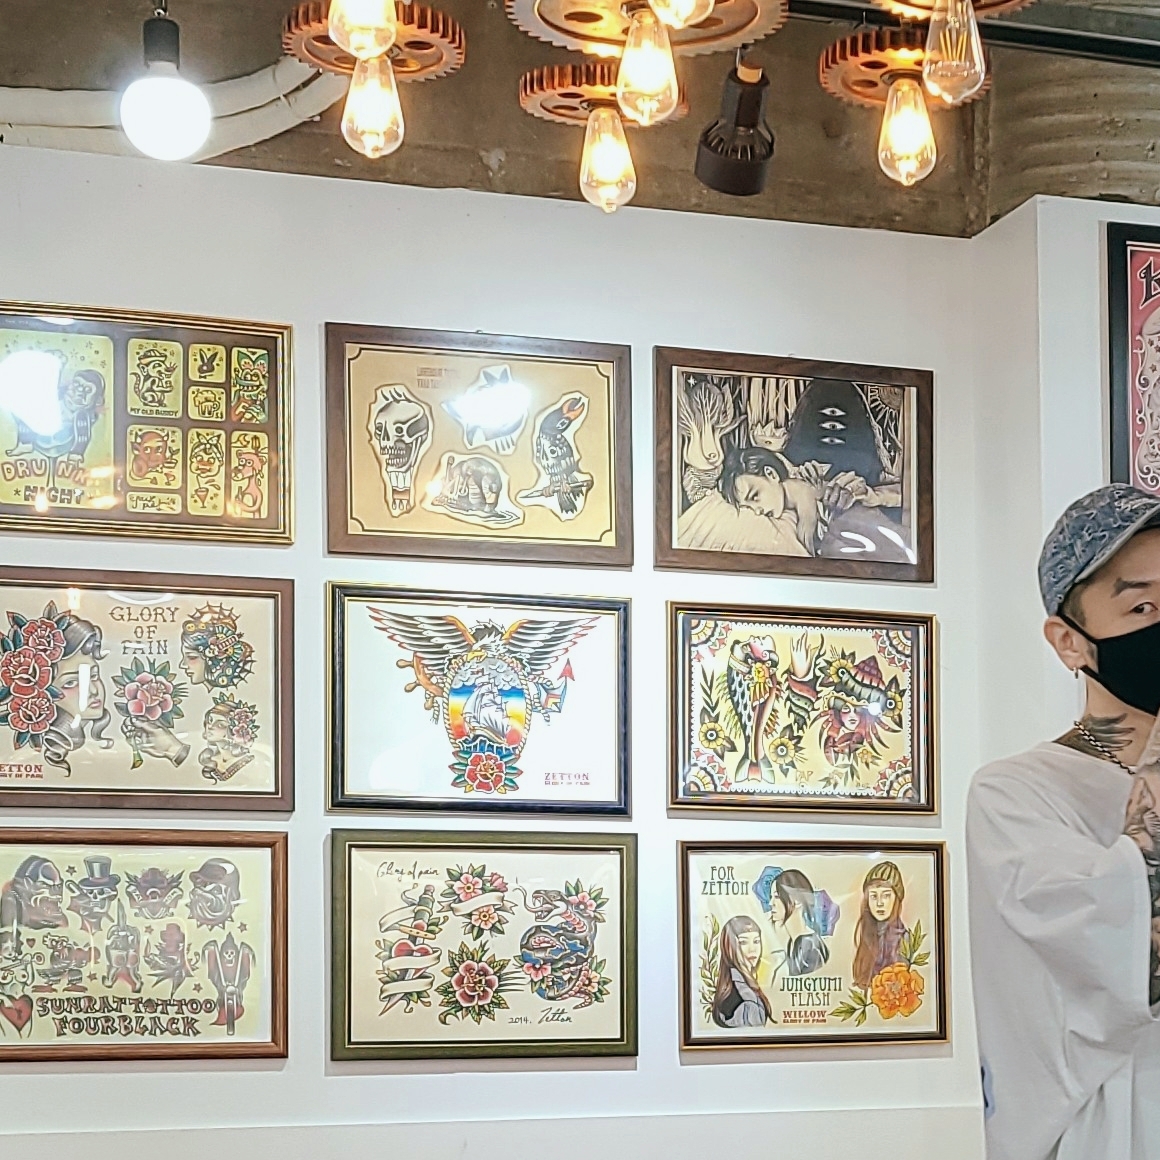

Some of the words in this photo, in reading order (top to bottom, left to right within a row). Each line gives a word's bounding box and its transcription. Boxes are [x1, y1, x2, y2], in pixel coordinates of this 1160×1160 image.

[109, 606, 180, 623] GLORY
[134, 625, 157, 639] OF
[122, 640, 168, 655] PAIN
[711, 866, 734, 880] FOR
[702, 881, 749, 895] ZETTON
[780, 977, 842, 991] JUNGYUMI
[790, 992, 831, 1006] FLASH
[783, 1010, 827, 1018] WILLOW
